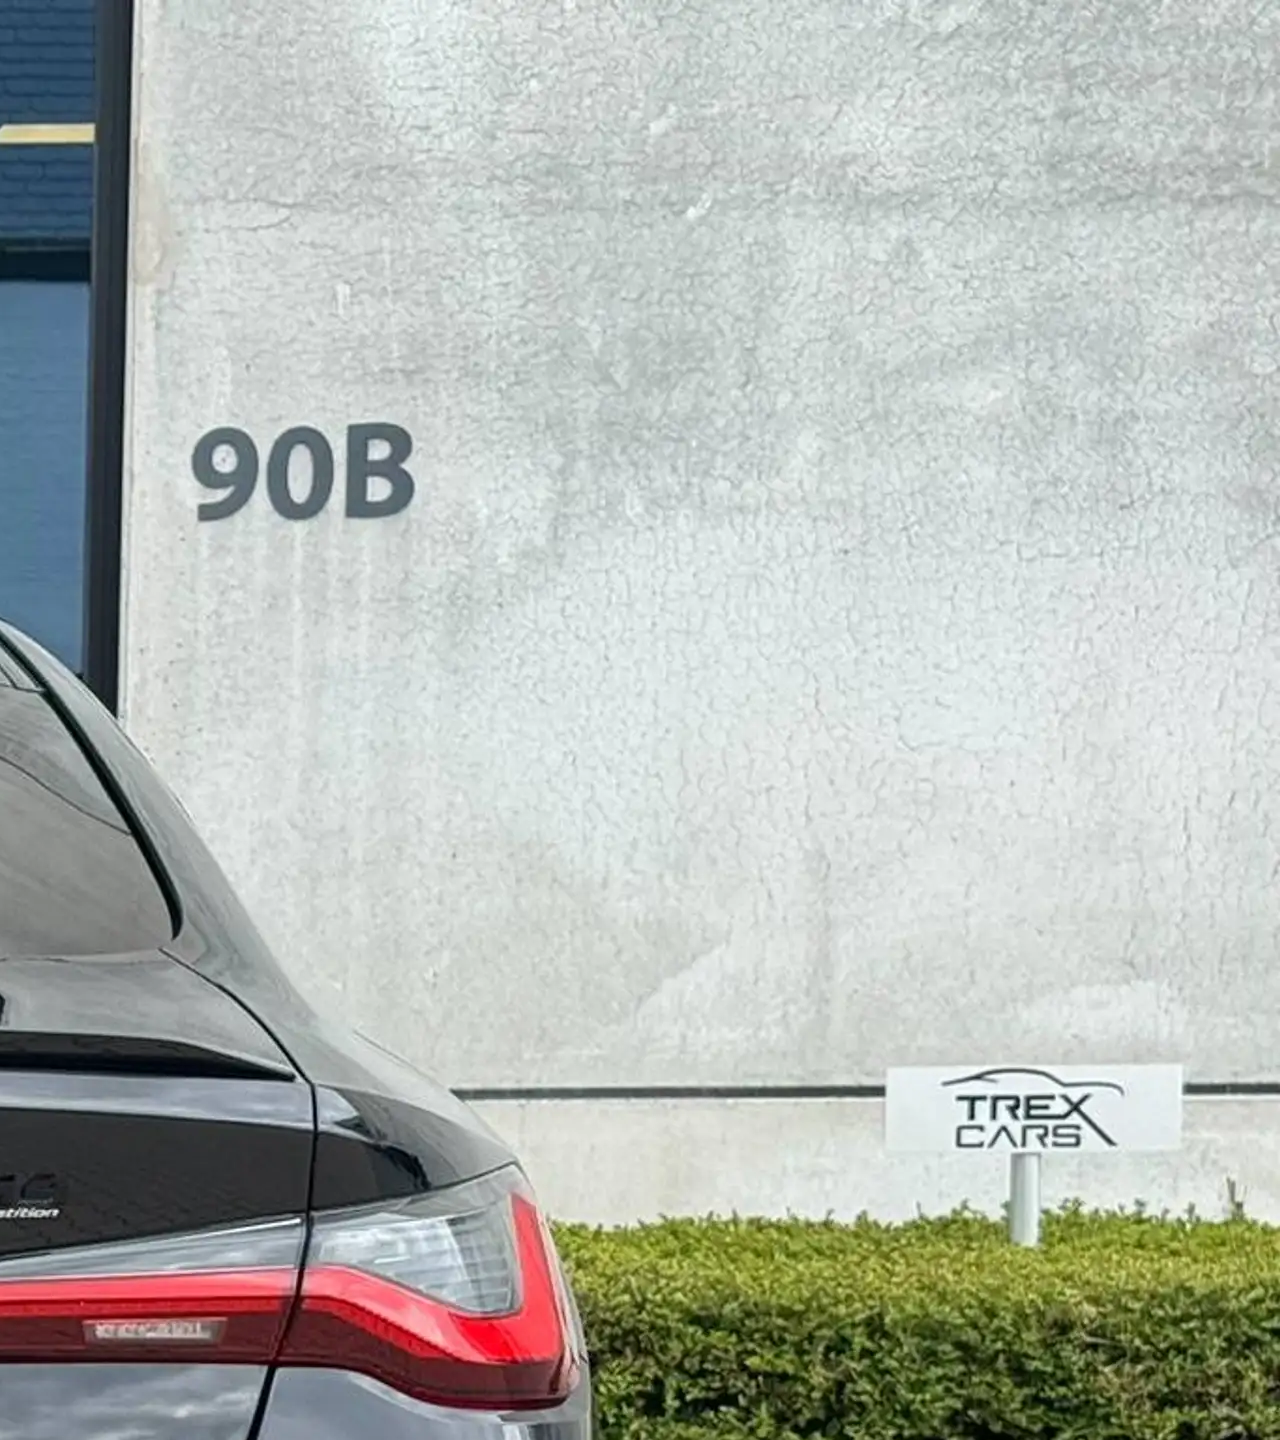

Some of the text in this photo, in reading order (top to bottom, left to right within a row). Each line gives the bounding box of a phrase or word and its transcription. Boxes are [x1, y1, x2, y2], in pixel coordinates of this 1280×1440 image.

[191, 422, 415, 522] 90B
[954, 1124, 1083, 1148] CARS
[955, 1092, 1118, 1147] TREX
